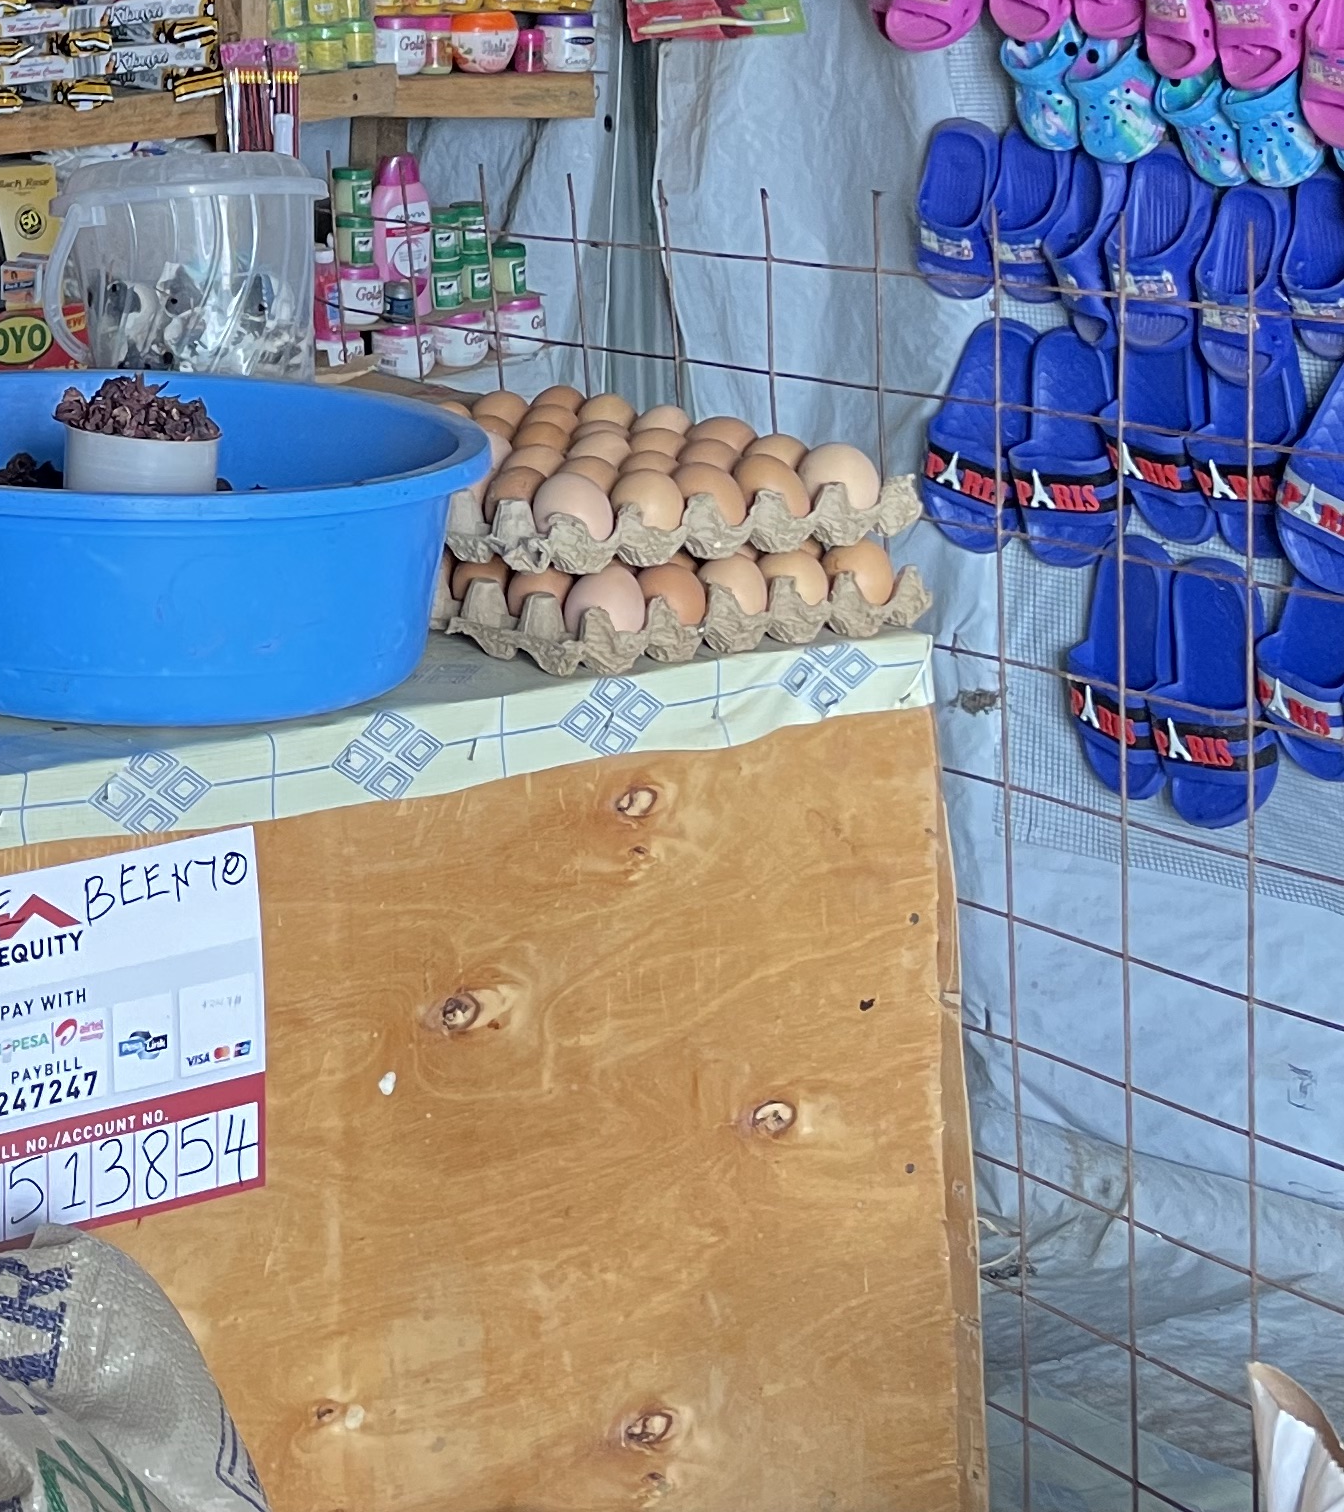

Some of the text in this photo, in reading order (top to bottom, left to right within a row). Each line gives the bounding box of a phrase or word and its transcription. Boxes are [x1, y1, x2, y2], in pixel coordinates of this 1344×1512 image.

[20, 210, 41, 229] 50
[0, 987, 87, 1021] PAY WITH
[185, 1051, 212, 1067] VISA
[11, 1055, 83, 1085] PAYBILL
[141, 1109, 171, 1127] NO.
